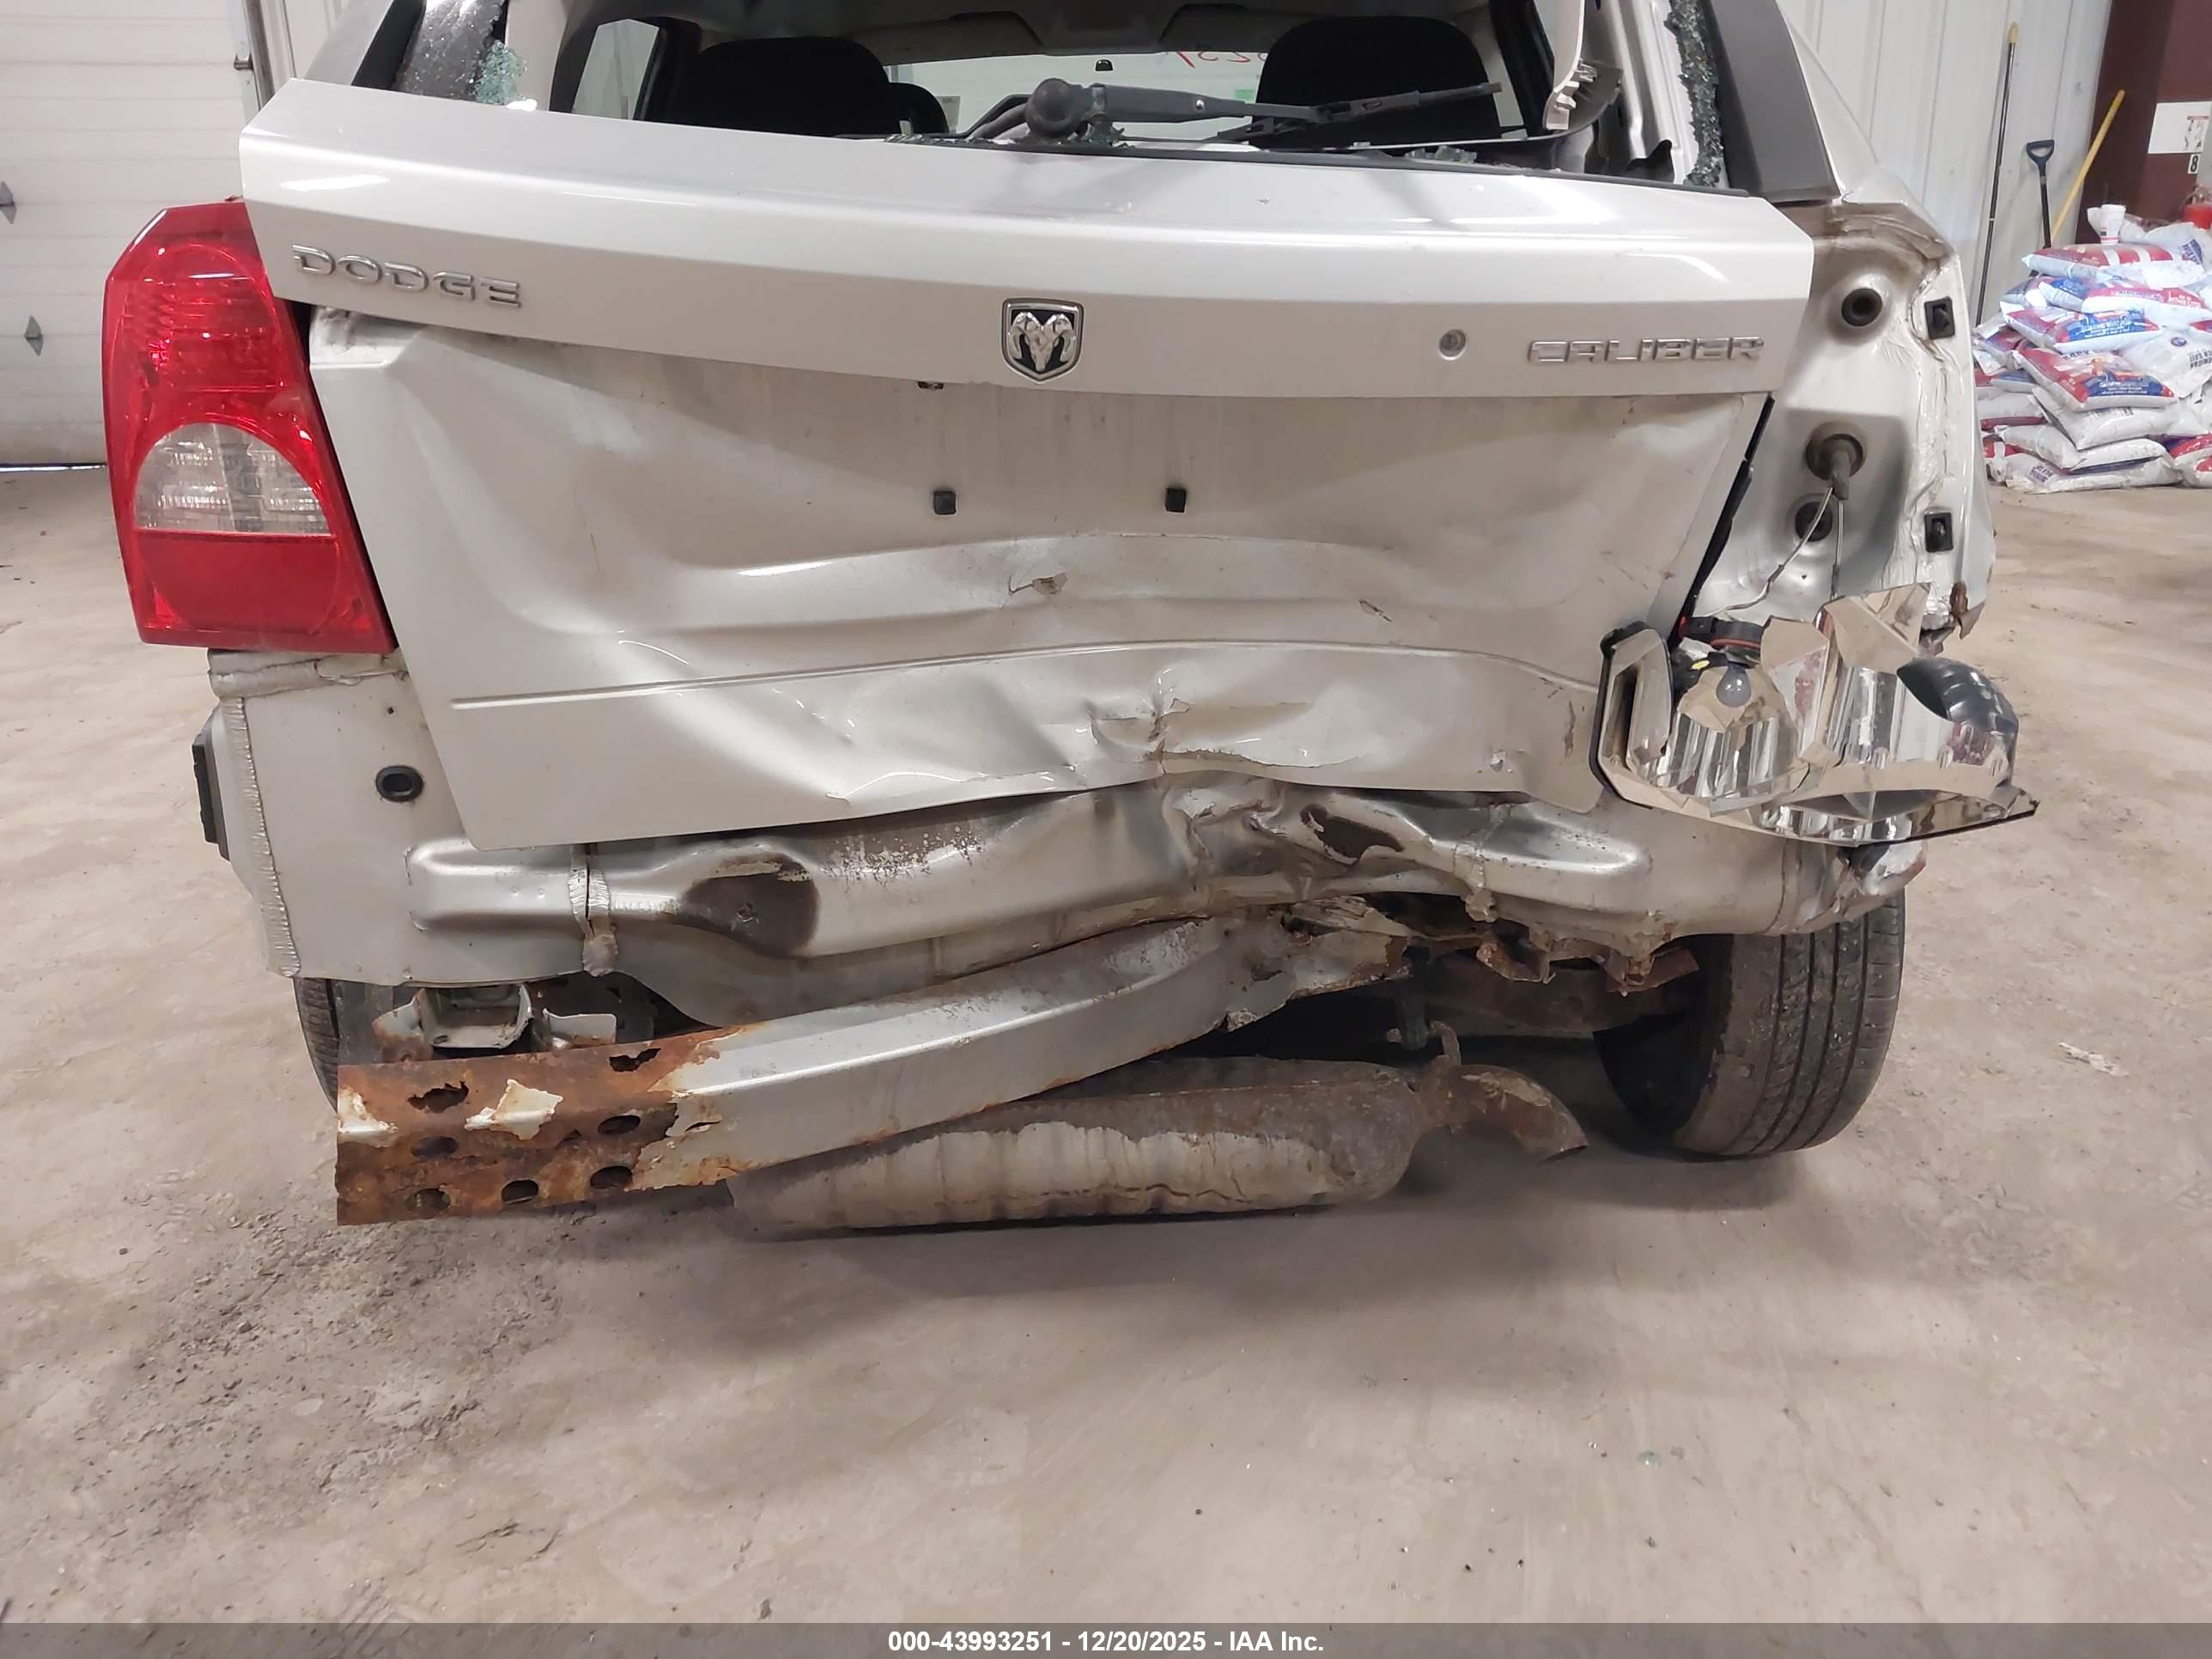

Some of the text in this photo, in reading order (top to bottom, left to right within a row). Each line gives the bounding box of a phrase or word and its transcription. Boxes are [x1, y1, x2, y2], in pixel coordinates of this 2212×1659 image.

[2191, 155, 2199, 173] 8
[291, 244, 522, 308] DODGE
[1527, 337, 1764, 362] CALIBER
